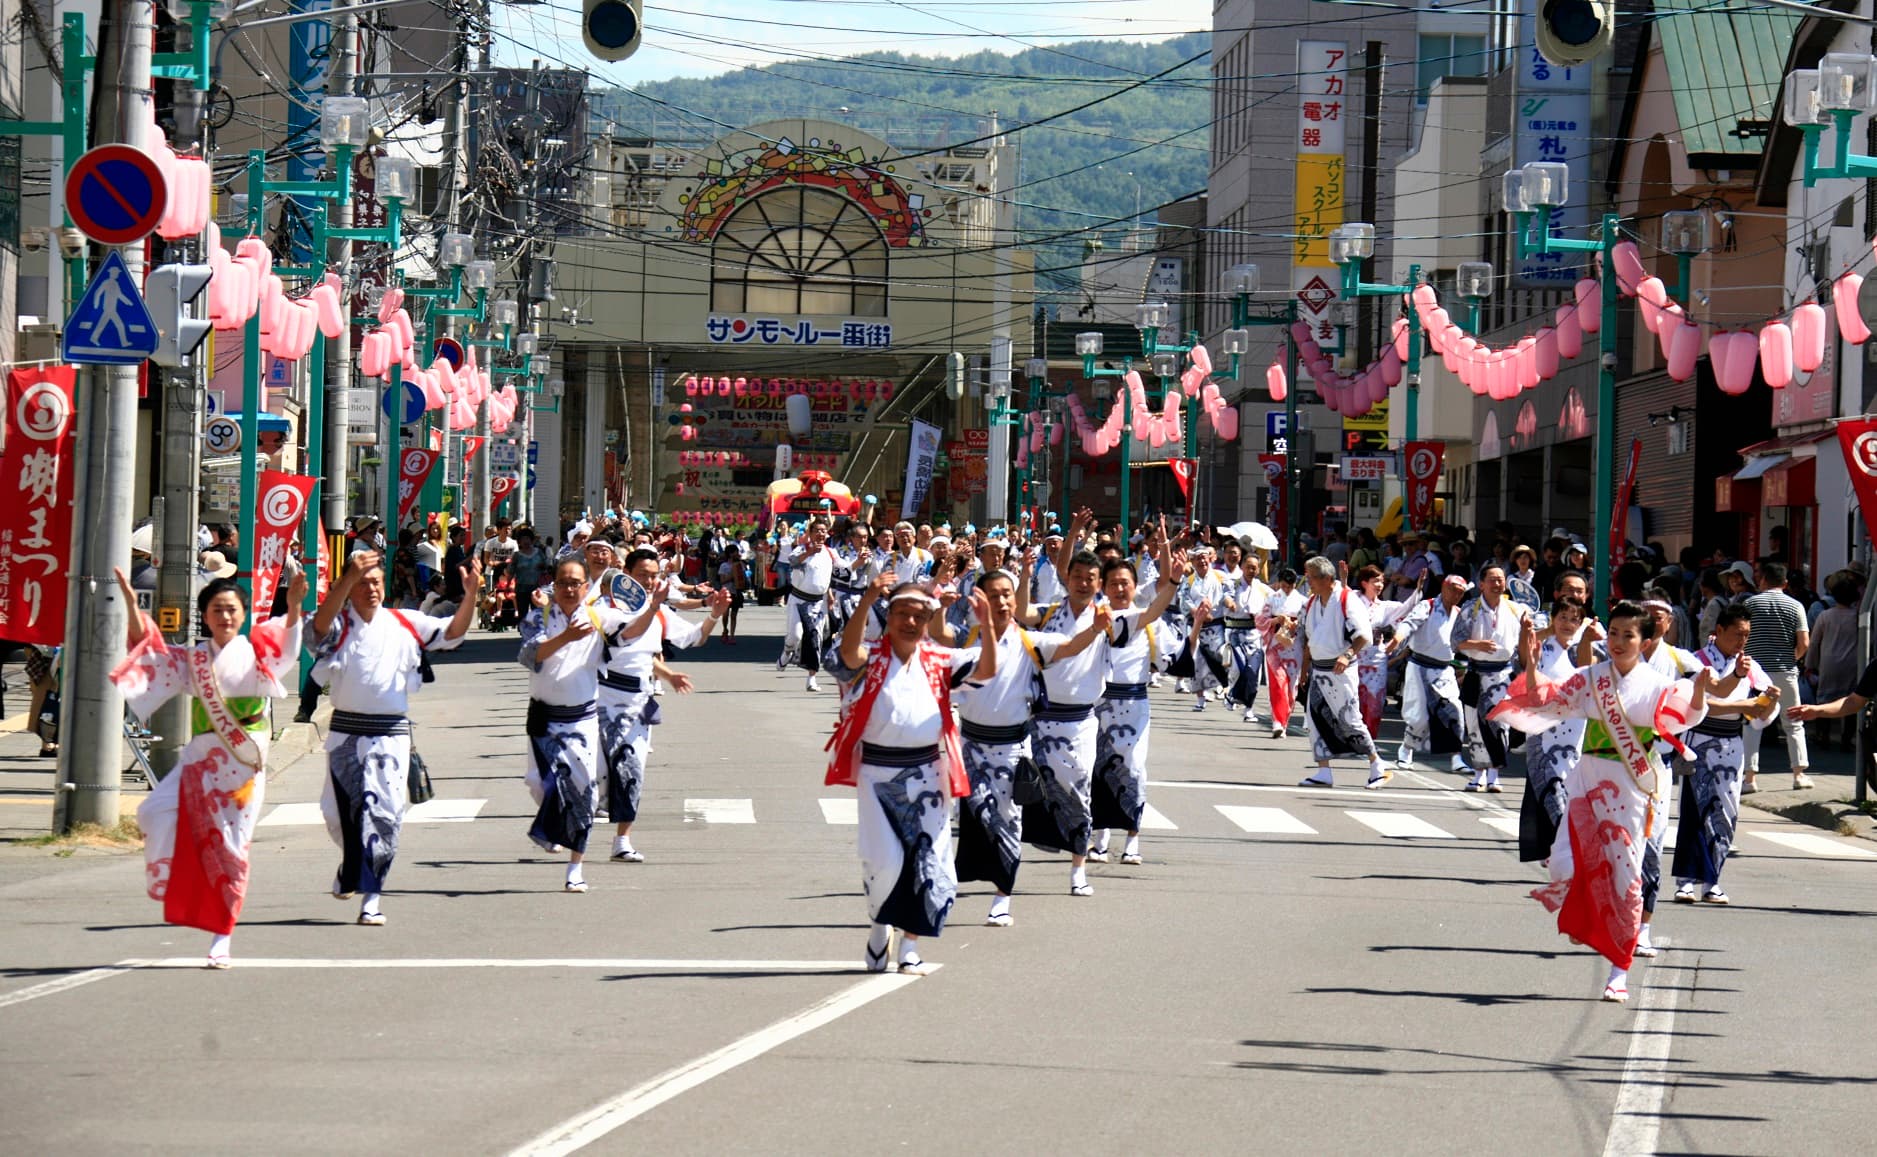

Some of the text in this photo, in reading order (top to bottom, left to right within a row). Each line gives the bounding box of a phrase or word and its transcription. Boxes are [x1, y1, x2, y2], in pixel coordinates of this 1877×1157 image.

[1324, 50, 1345, 121] アカオ
[1302, 101, 1322, 147] 電器
[1311, 185, 1326, 235] スクール
[1327, 157, 1342, 205] パソコン
[1347, 432, 1361, 450] P
[12, 447, 59, 628] 潮まつり
[193, 650, 247, 749] おたるミス潮
[1596, 675, 1649, 777] おたるミス潮
